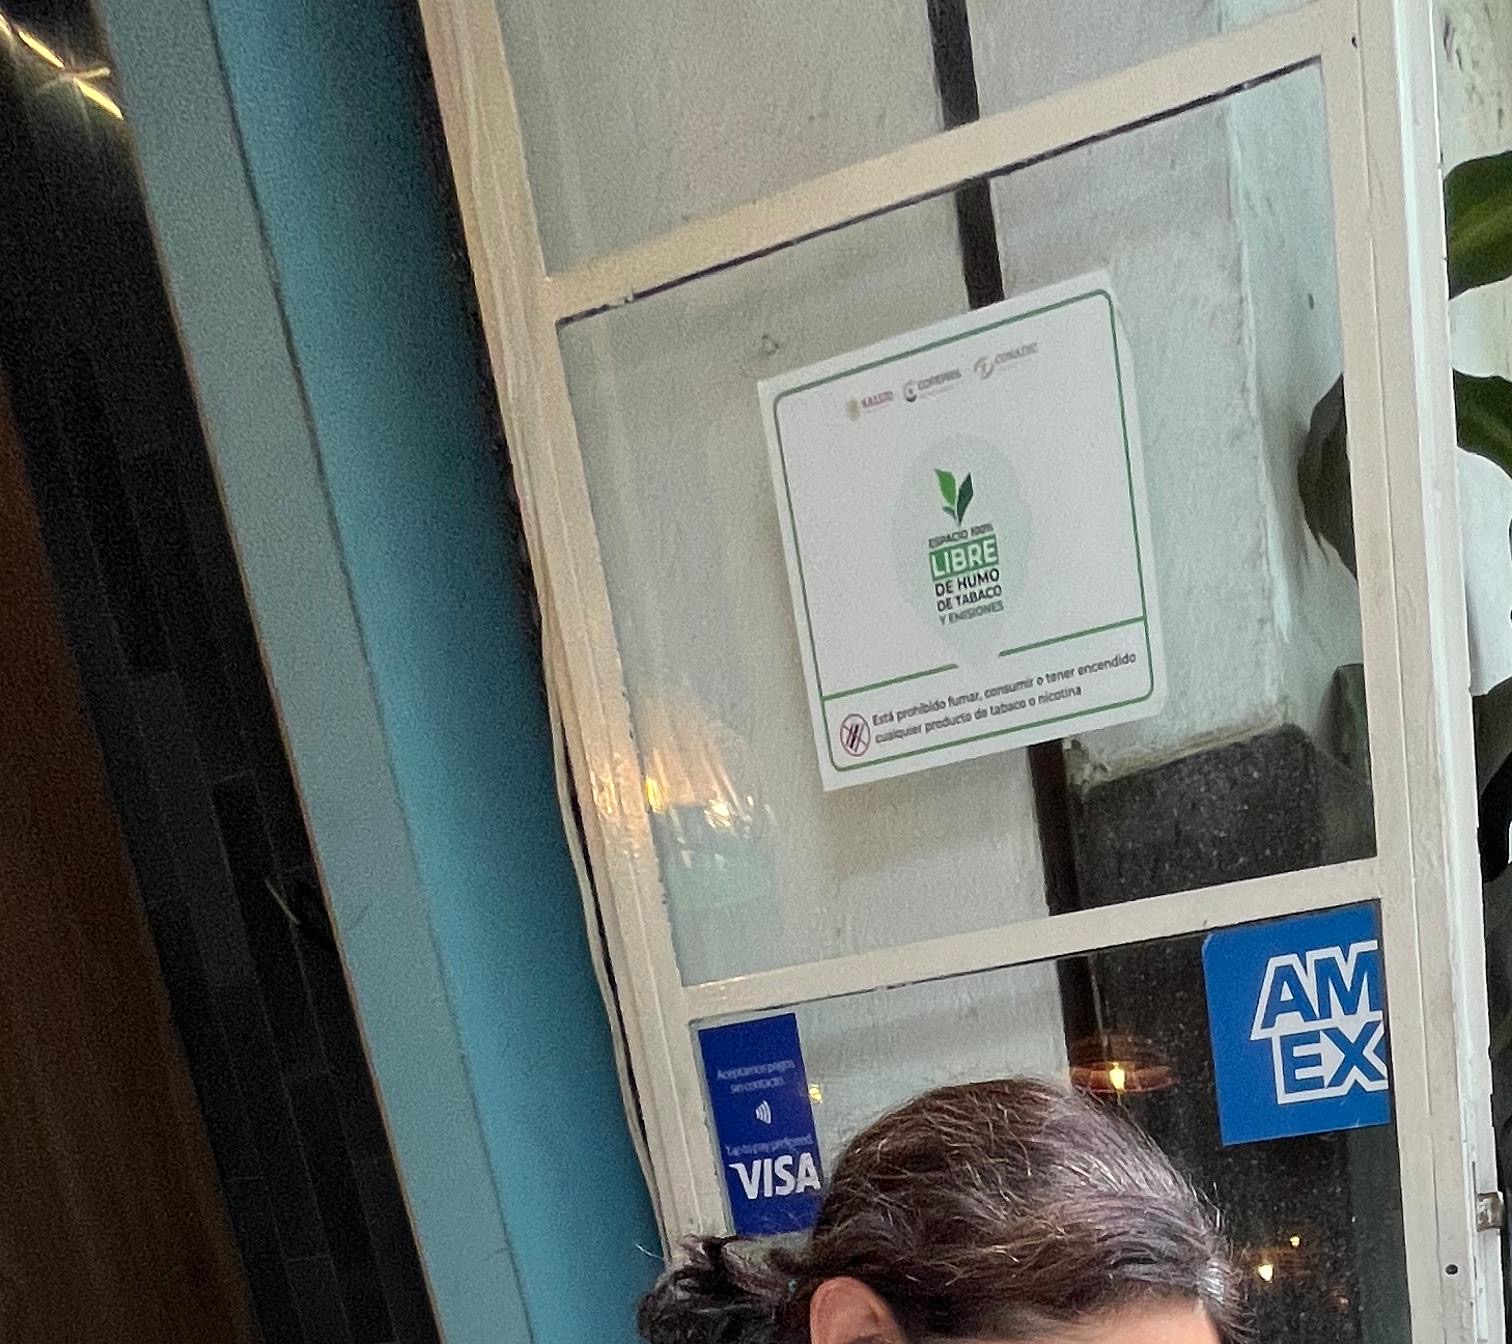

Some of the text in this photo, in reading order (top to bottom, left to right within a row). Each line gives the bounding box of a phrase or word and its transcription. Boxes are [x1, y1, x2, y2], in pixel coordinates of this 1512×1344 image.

[931, 538, 998, 577] LIBRE
[935, 568, 1000, 597] DE HUMO
[937, 584, 1002, 612] DE TABACO
[939, 615, 947, 626] Y
[872, 652, 1137, 727] Está prohibido fumar, consumir o tener encendido
[875, 686, 1082, 744] cualquier producto de tabaco o nicotina
[729, 1152, 821, 1200] VISA
